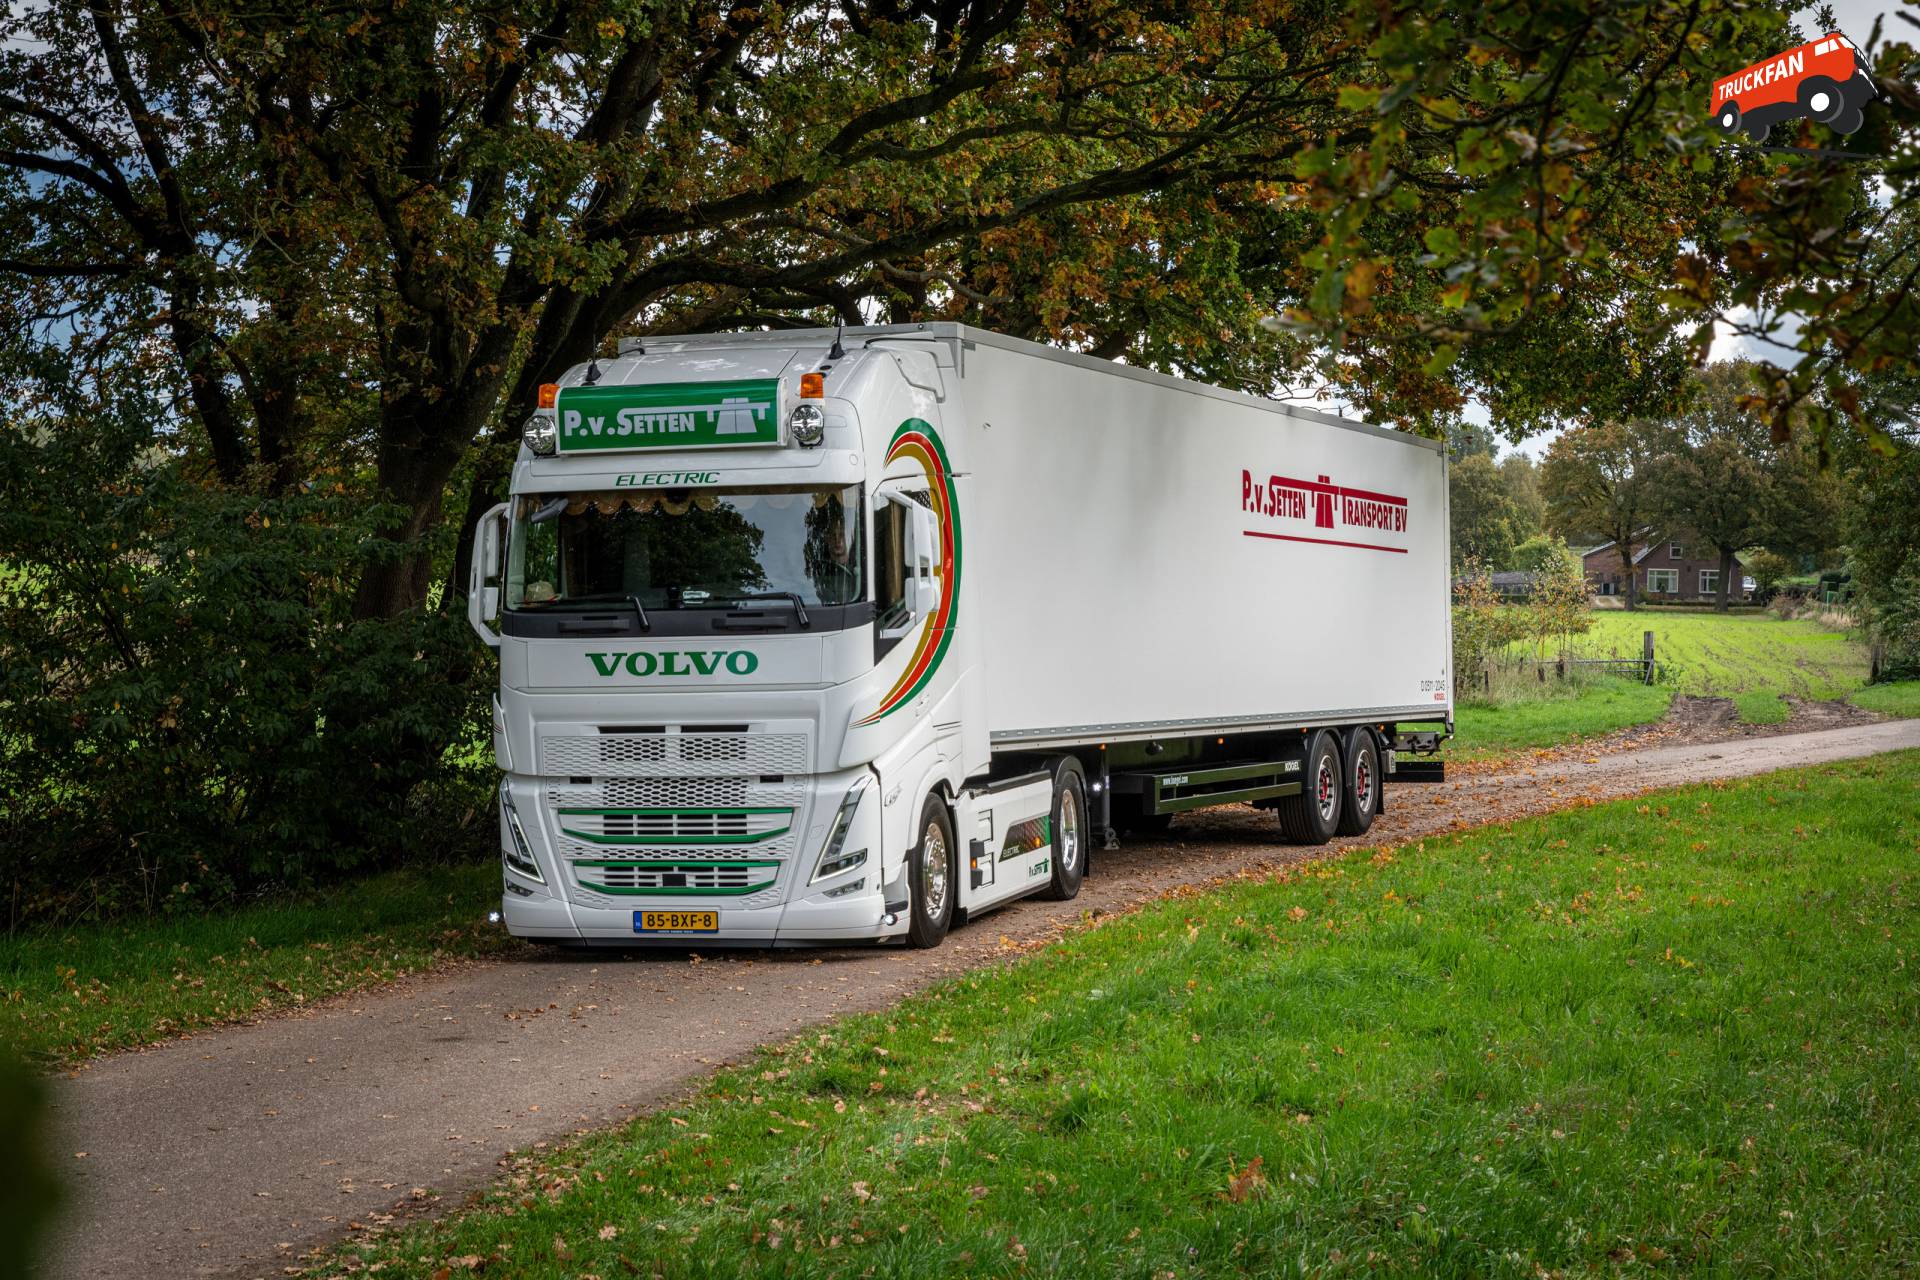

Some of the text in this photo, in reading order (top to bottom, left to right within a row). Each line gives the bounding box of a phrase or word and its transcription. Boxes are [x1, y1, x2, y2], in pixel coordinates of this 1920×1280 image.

[615, 471, 721, 487] ELECTRIC
[1342, 487, 1393, 530] TRANSPORT
[1395, 507, 1408, 533] BV
[585, 650, 759, 677] VOLVO
[646, 913, 712, 928] 85-BXF-8
